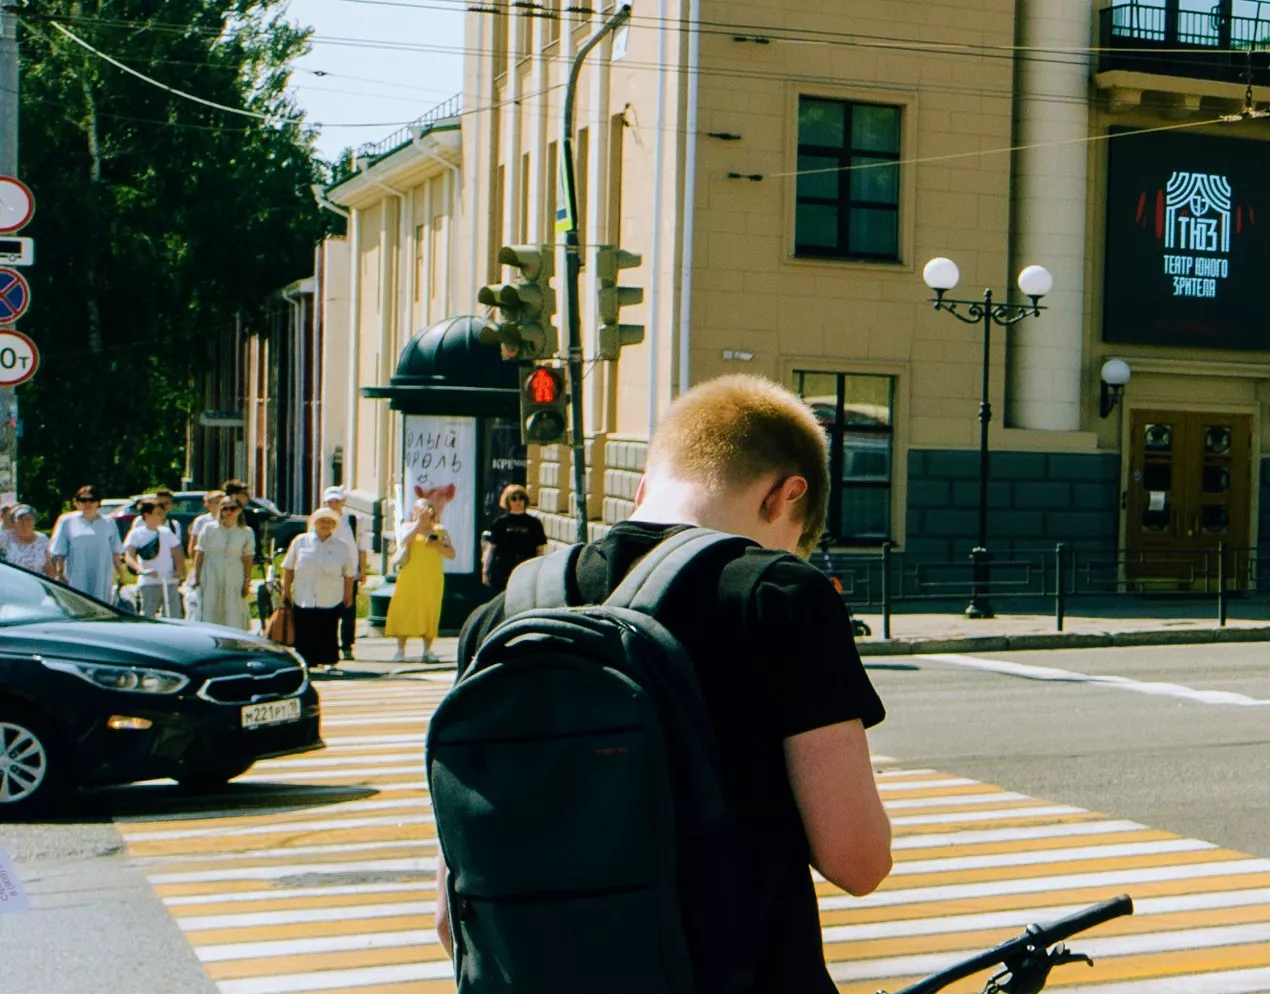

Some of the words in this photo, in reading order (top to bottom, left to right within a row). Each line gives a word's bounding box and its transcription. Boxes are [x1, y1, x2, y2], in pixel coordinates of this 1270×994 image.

[1178, 216, 1217, 251] ТЮЗ
[1164, 255, 1192, 275] ТЕАТР
[1195, 257, 1228, 278] ЮНОГО
[1173, 277, 1216, 297] ЗРИТЕЛЯ
